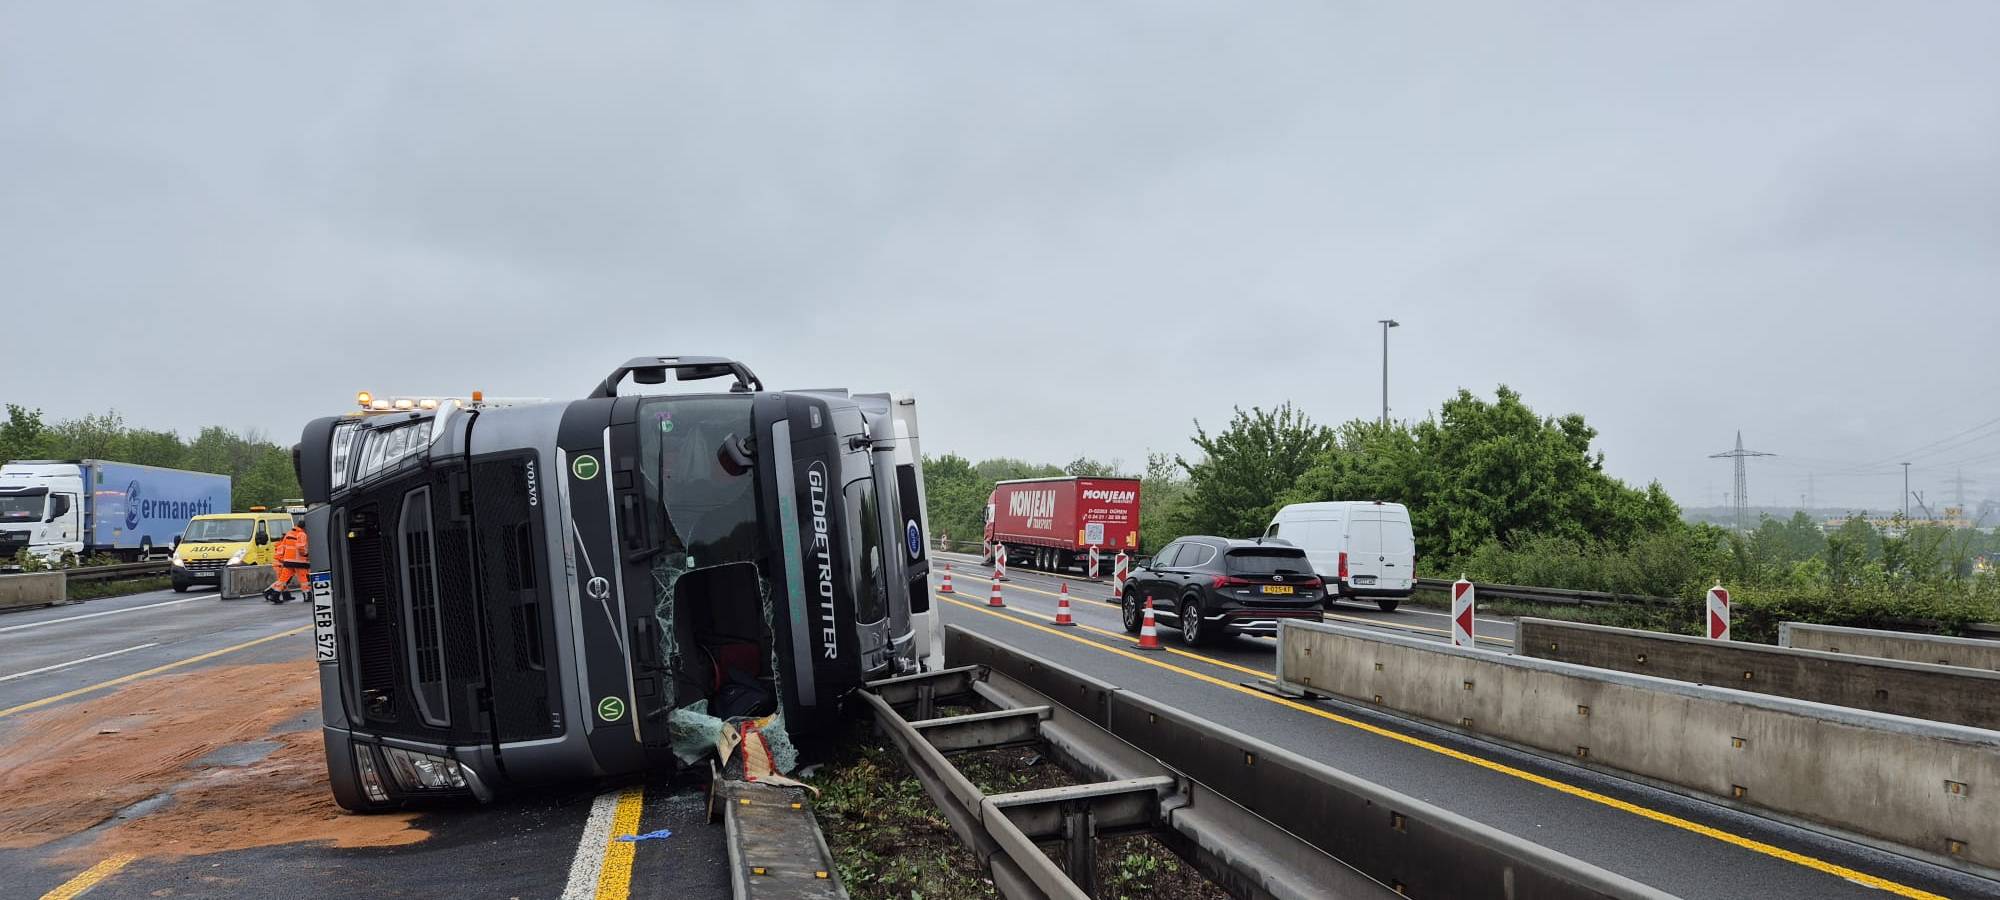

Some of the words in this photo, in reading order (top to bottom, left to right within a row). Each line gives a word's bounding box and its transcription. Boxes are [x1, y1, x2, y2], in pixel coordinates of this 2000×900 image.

[527, 460, 537, 506] VOLVO
[1083, 489, 1135, 503] MONJEAN
[1009, 490, 1055, 528] MONJEAN
[808, 470, 837, 659] GLOBETROTTER
[314, 582, 330, 596] 31
[316, 604, 332, 628] AFB
[318, 633, 334, 658] 572
